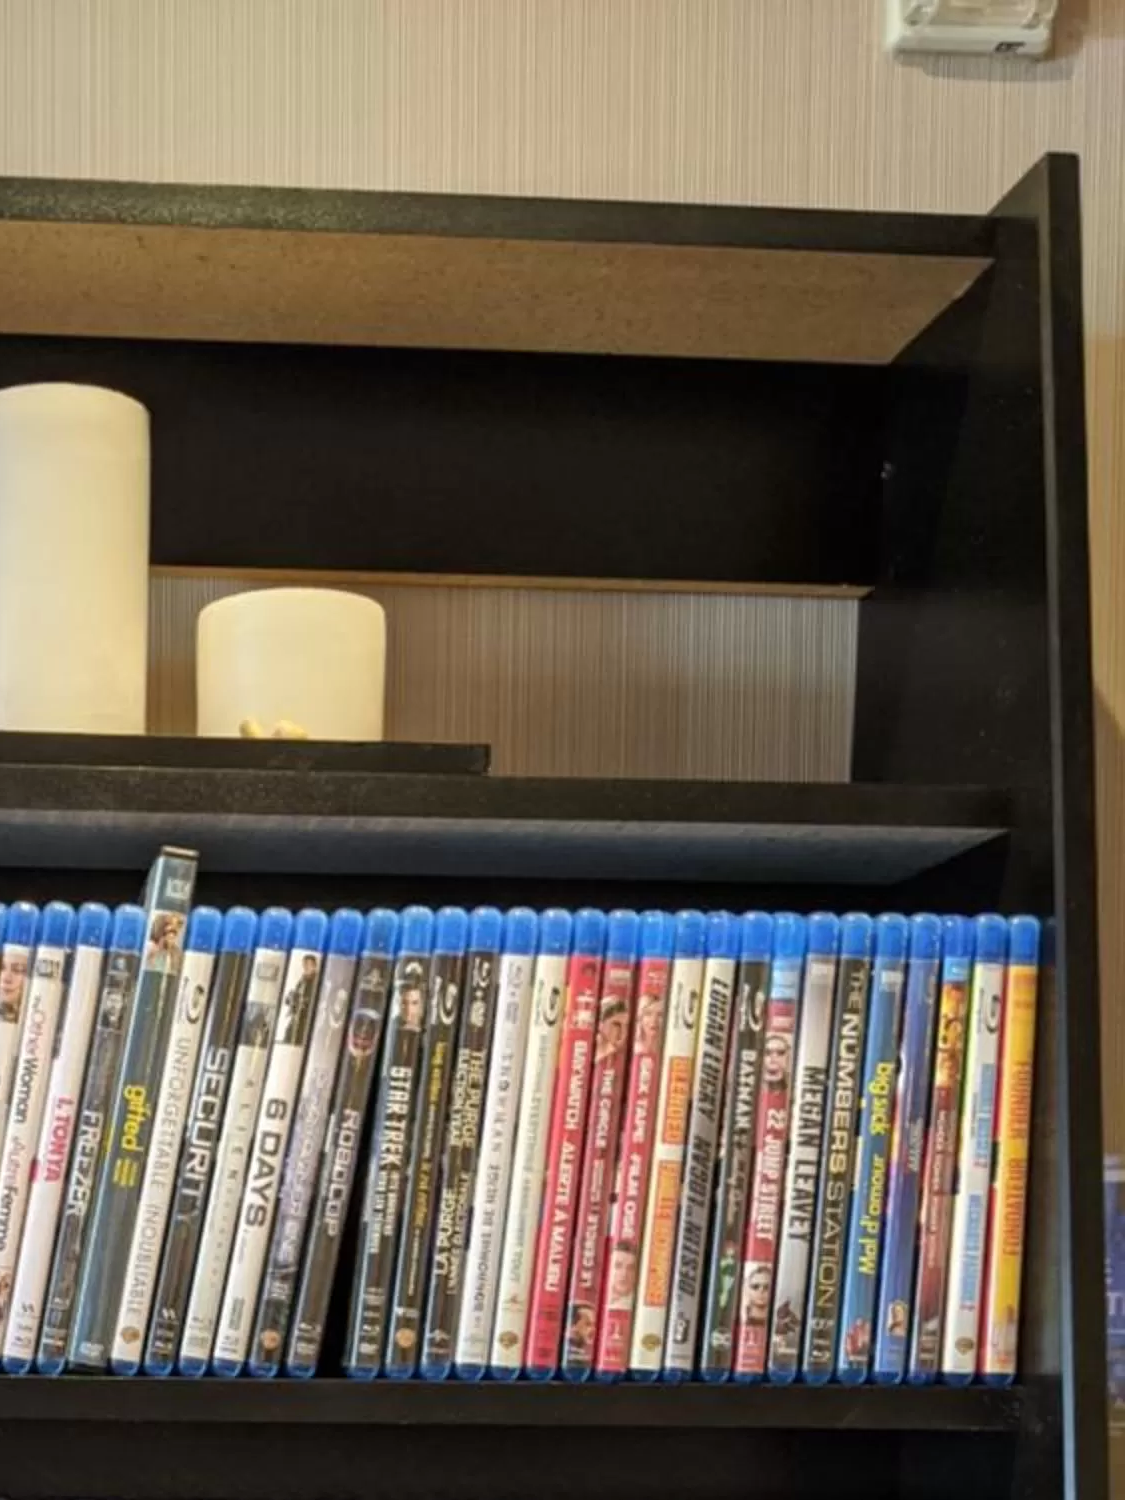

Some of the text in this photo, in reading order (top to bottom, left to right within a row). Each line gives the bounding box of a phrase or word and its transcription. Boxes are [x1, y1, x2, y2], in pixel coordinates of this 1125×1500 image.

[565, 1040, 589, 1130] BAYWATCH
[636, 1055, 654, 1093] SEX
[694, 977, 730, 1120] LOGAN LUCKY
[732, 1049, 758, 1131] BATMAN
[119, 1086, 155, 1151] gifted
[148, 1037, 194, 1189] UNFORGETTABLE
[173, 1044, 232, 1225] SECURITY
[378, 1066, 412, 1169] STAR TREK
[594, 1069, 616, 1148] THE CIRCLE
[632, 1100, 650, 1144] TAPE
[786, 1066, 827, 1241] MEGAN LEAVEY
[815, 970, 866, 1309] THE NUMBERS STATION
[64, 1109, 106, 1220] FREEZER
[244, 1098, 289, 1229] 6 DAYS
[321, 1107, 364, 1238] ROBOCOP
[556, 1139, 578, 1205] ALERTE
[626, 1154, 644, 1195] FILM
[753, 1108, 786, 1241] 22 JUMP STREET
[543, 1229, 567, 1292] MALIBU
